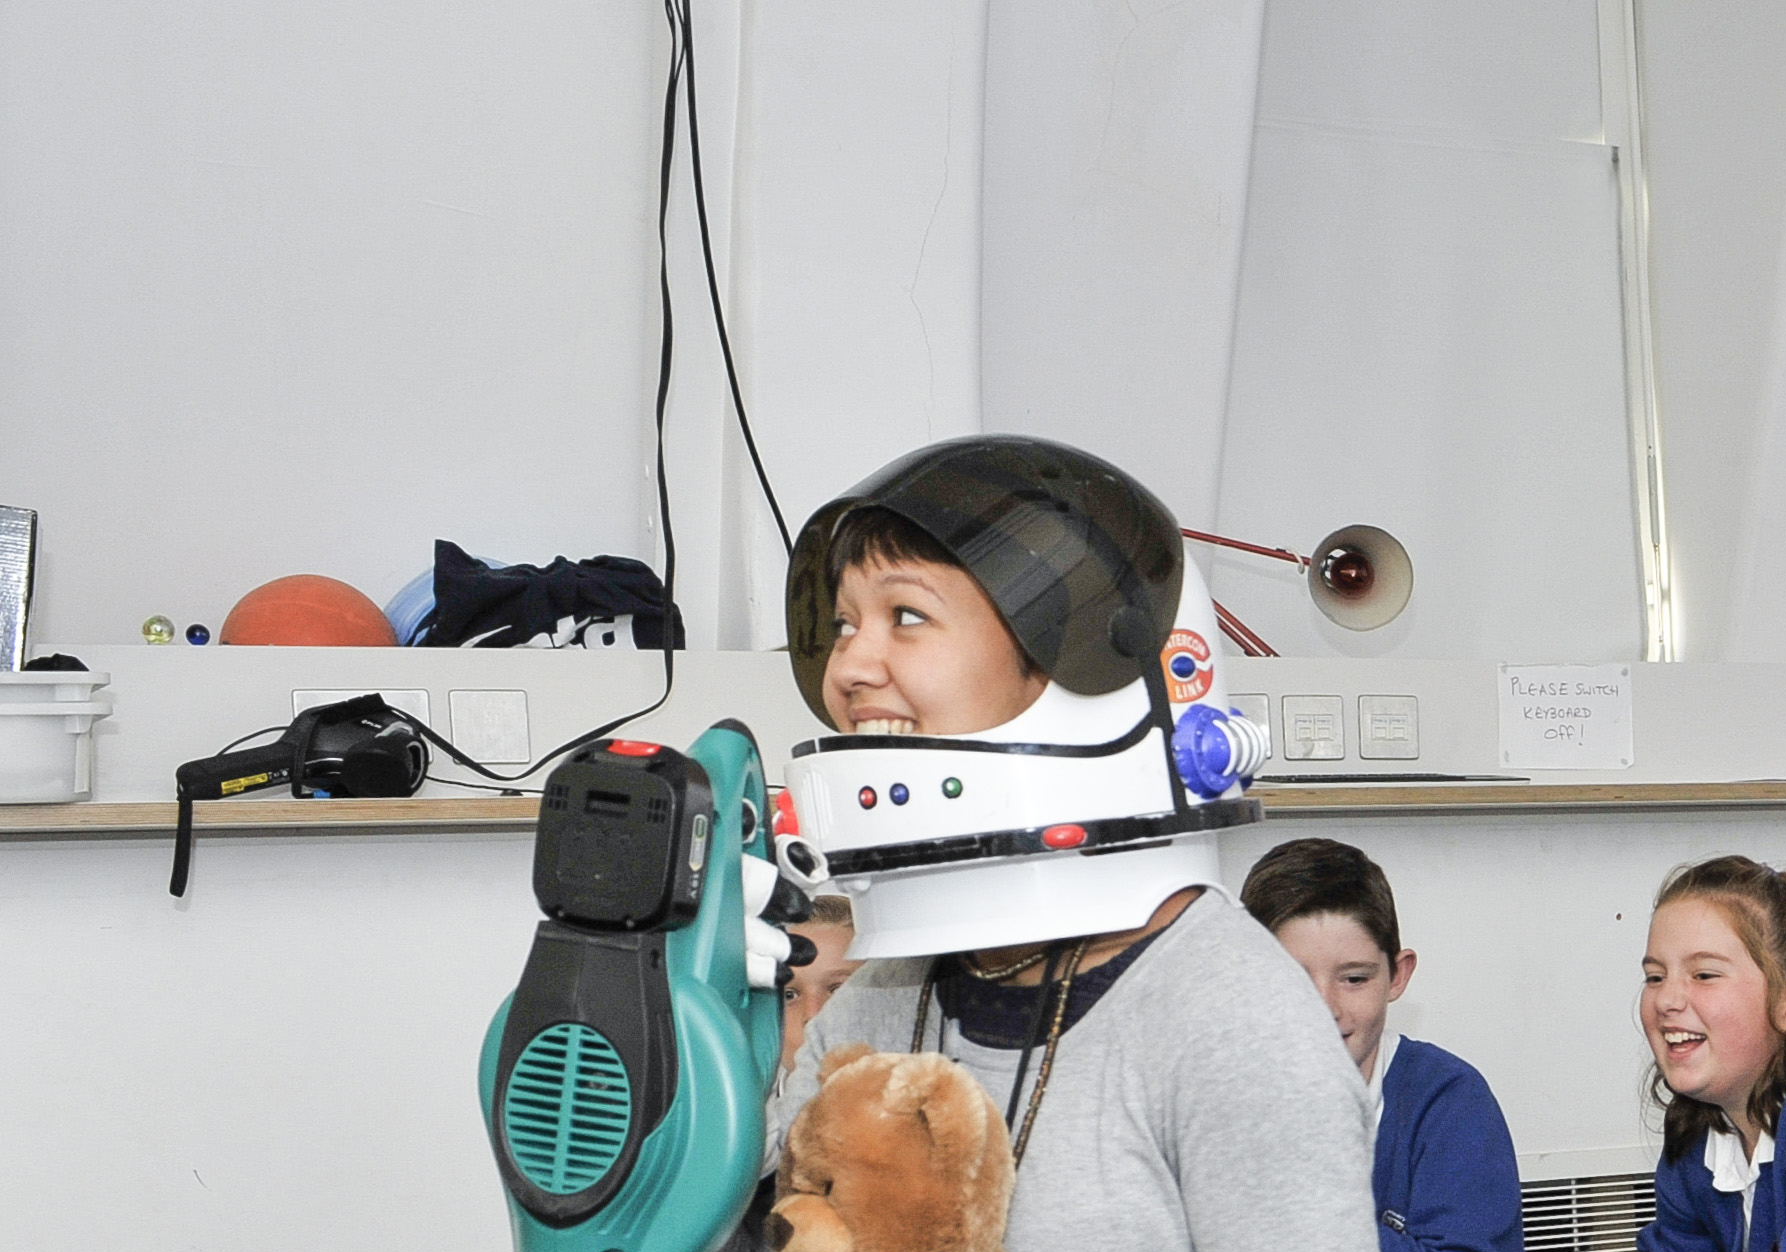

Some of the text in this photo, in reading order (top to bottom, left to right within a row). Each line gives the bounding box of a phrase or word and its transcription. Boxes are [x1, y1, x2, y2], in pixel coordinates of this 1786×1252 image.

[1174, 678, 1204, 699] LINK
[1510, 676, 1569, 696] PLEASE
[1523, 706, 1592, 719] KEYBOARD
